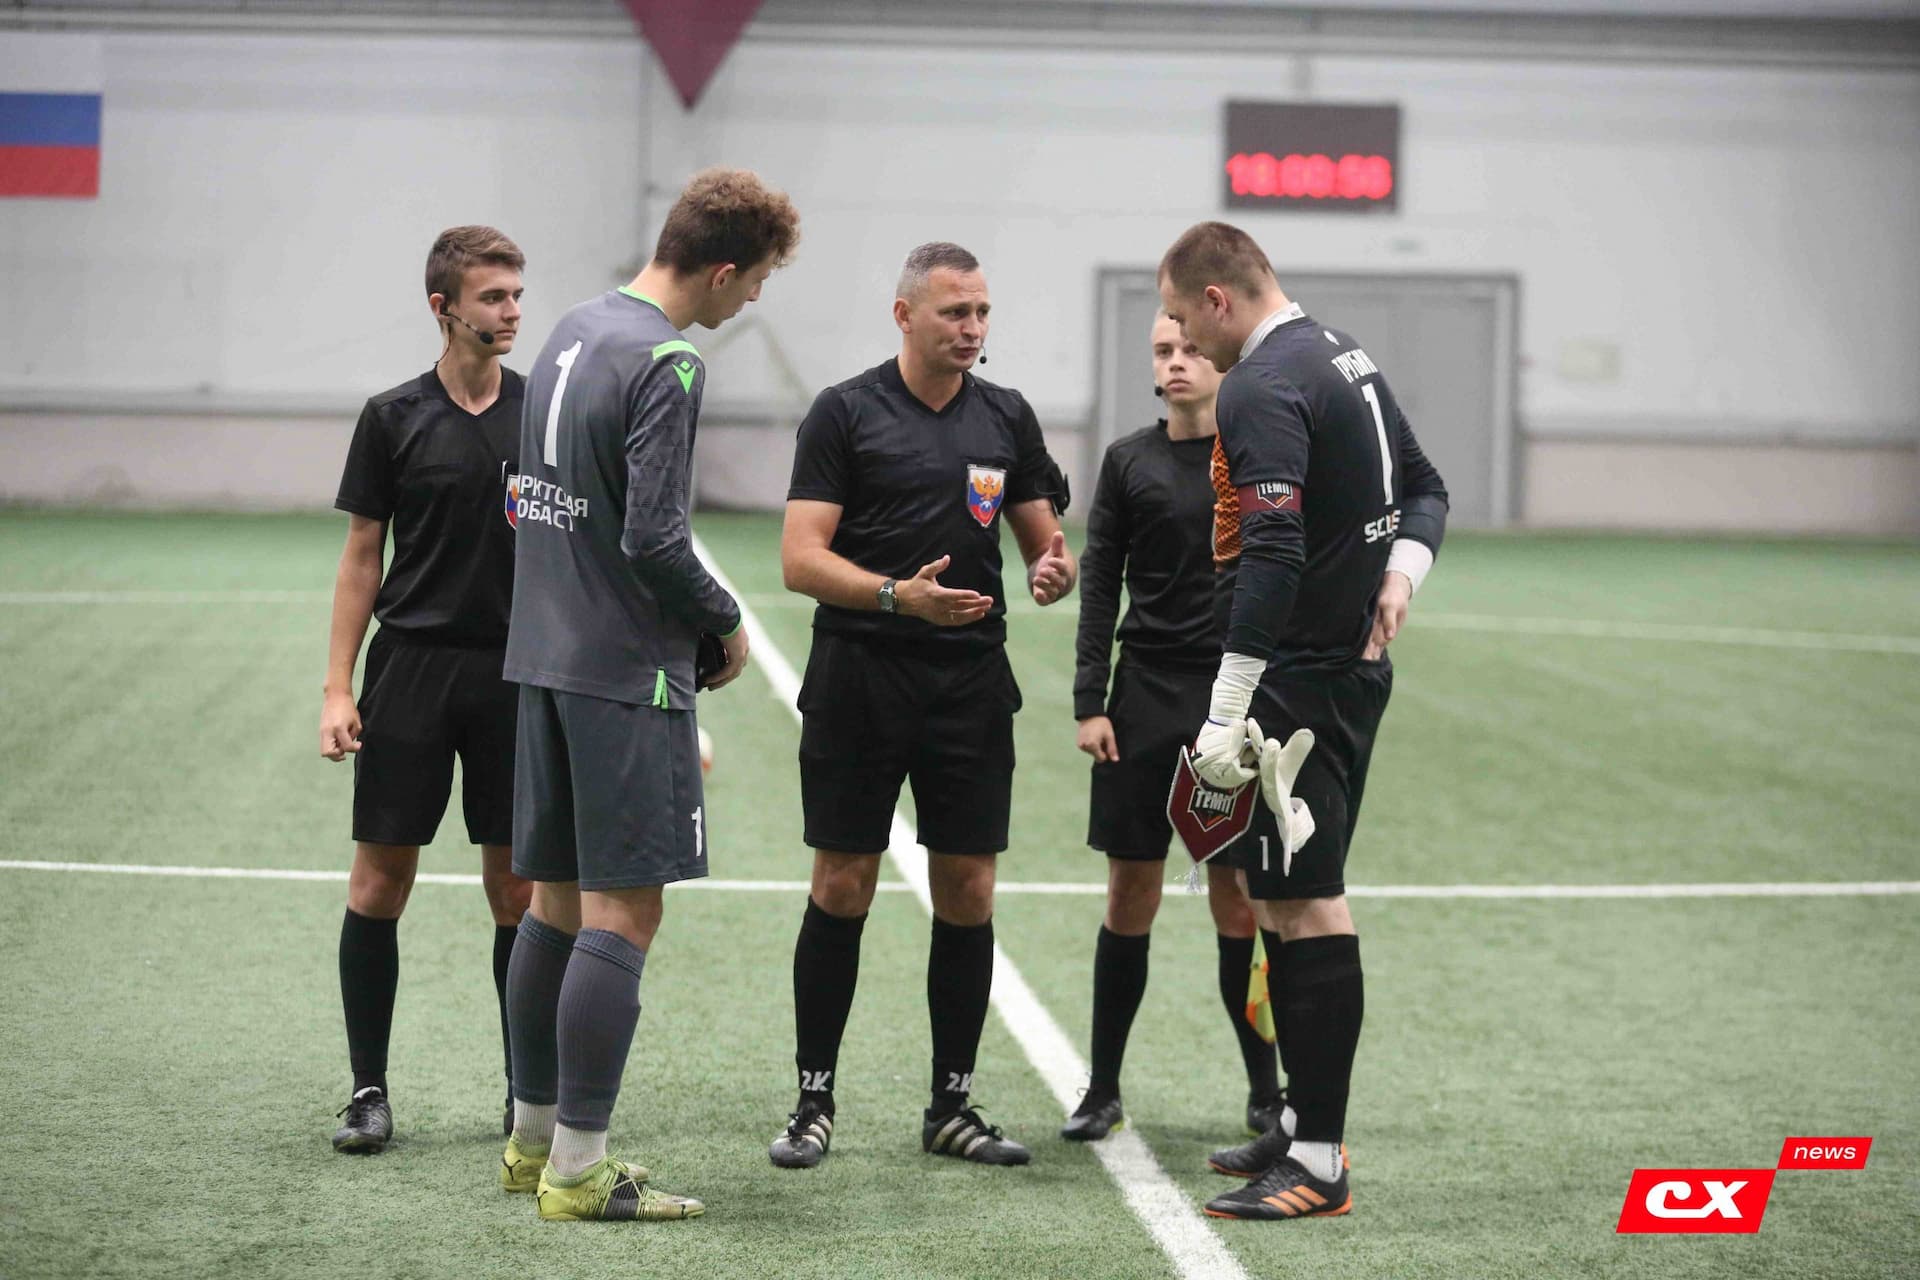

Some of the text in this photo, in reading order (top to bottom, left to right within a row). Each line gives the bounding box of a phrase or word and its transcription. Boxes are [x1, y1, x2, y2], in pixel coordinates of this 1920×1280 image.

[544, 340, 582, 467] 1
[1361, 383, 1393, 505] 1
[691, 806, 702, 856] 1
[1260, 836, 1269, 871] 1
